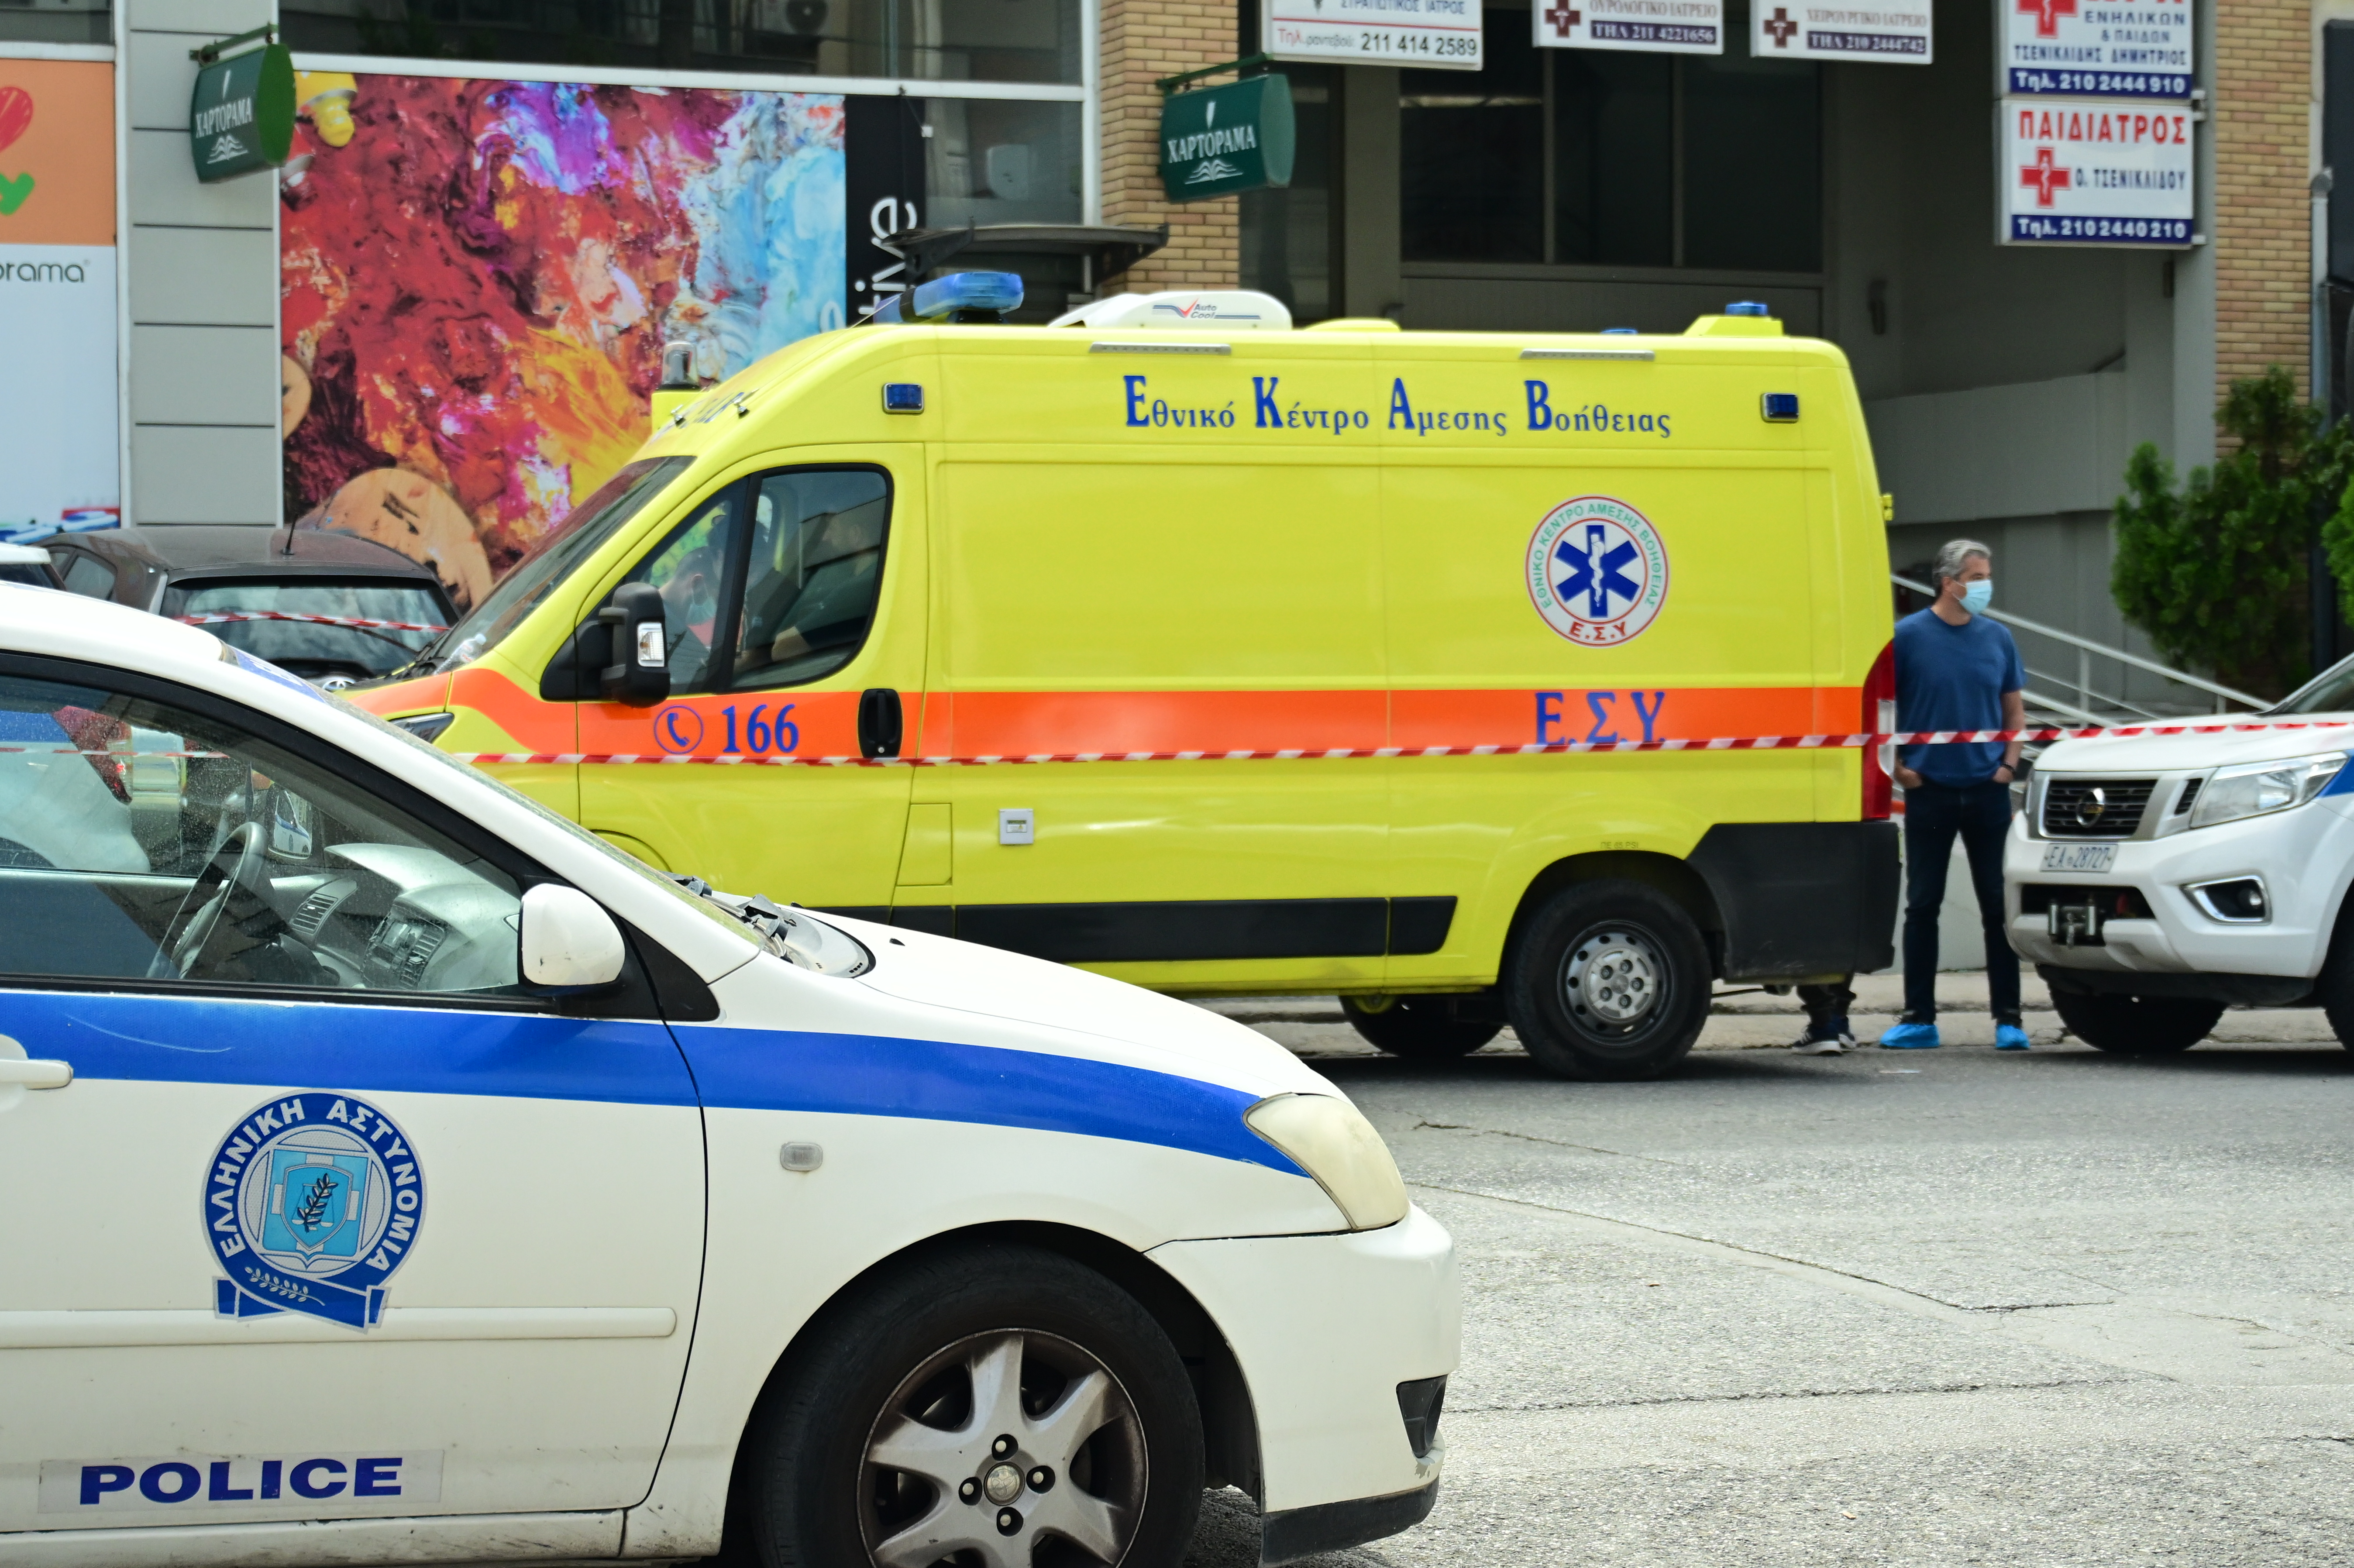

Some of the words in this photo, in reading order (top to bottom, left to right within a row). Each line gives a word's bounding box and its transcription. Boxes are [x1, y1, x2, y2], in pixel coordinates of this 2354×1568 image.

[1426, 0, 1466, 15] ΙΑΤΡΟΣ
[2085, 11, 2185, 25] ΕΝΗΛΙΚΩΝ
[1361, 33, 1391, 52] 211
[1397, 35, 1429, 55] 414
[1436, 37, 1477, 56] 2589
[1631, 25, 1655, 40] 211
[2016, 71, 2055, 93] Τηλ.
[196, 96, 253, 139] ΧΑΡΤΟΡΑΜΑ
[2019, 111, 2186, 145] ΠΑΙΔΙΑΤΡΟΣ
[1167, 124, 1257, 164] ΧΑΡΤΟΡΑΜΑ
[2094, 169, 2186, 190] ΤΣΕΝΙΚΛΙΔΟΥ
[2018, 219, 2057, 239] Τηλ.
[1190, 311, 1217, 320] Cool
[1193, 303, 1218, 312] Auto
[1123, 375, 1235, 428] Εθνικό
[1252, 377, 1370, 436] Κέντρο
[1388, 378, 1507, 437] Αμεσης
[1524, 380, 1671, 439] Βοήθειας
[1538, 505, 1584, 547] ΚΕΝΤΡΟ
[1587, 503, 1640, 532] ΑΜΕΣΗΣ
[1532, 550, 1552, 609] ΕΘΝΙΚΟ
[1638, 530, 1662, 609] ΒΟΗΘΕΙΑΣ
[722, 704, 799, 753] 166
[211, 1098, 306, 1258] ΕΛΛΗΝΙΚΗ
[326, 1099, 418, 1272] ΑΣΤΥΝΟΜΙΑ
[80, 1457, 403, 1506] POLICE
